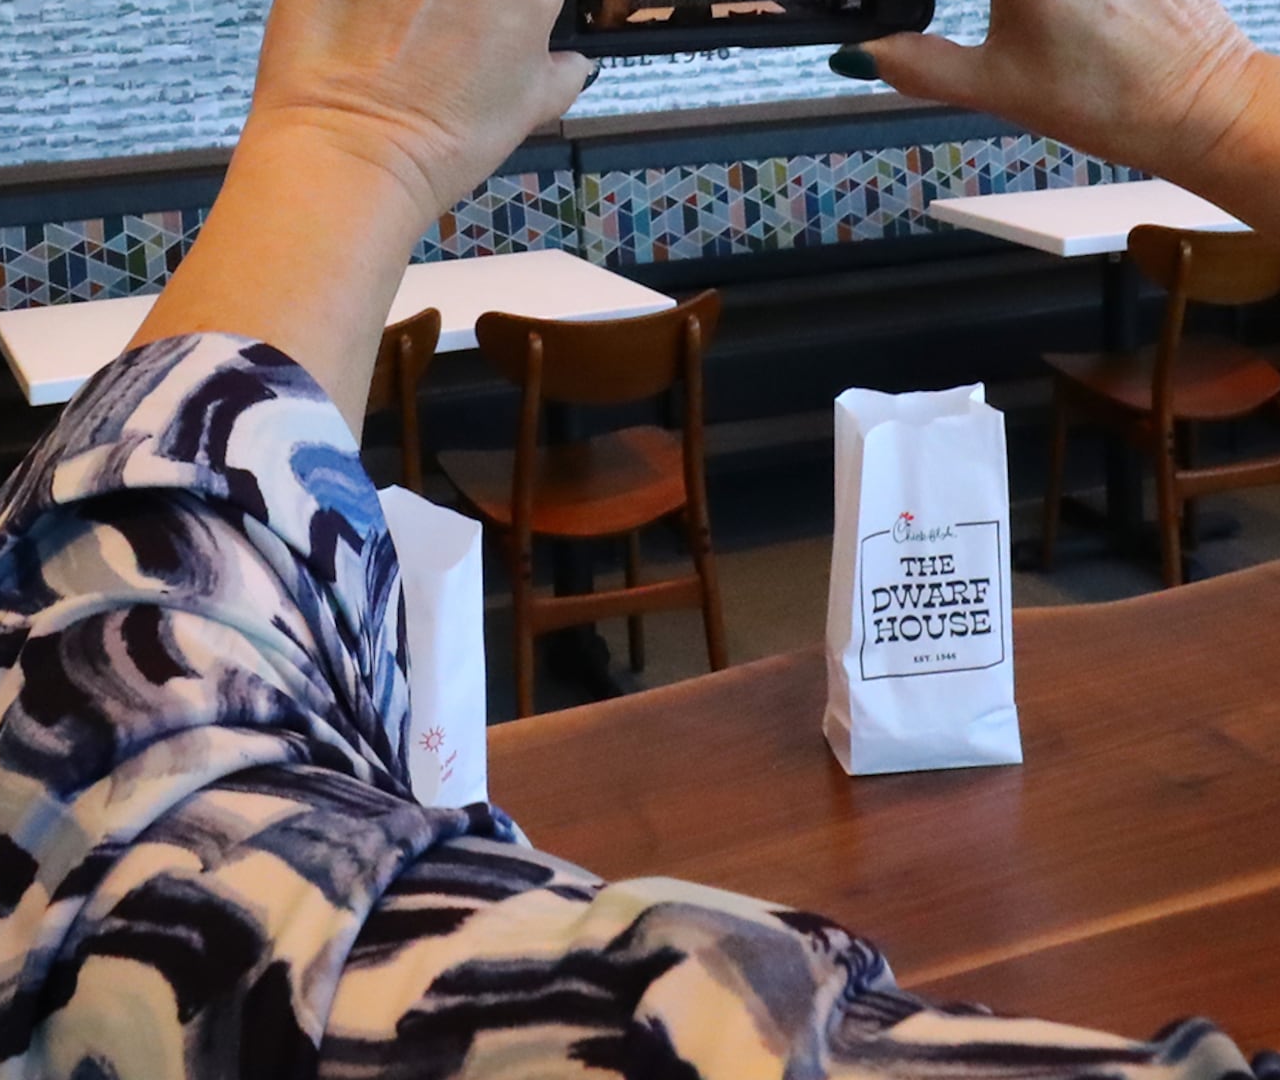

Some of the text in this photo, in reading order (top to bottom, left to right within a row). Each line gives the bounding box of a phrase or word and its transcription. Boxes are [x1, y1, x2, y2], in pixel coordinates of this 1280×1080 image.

[900, 554, 956, 577] THE
[871, 577, 991, 614] DWARF
[873, 610, 993, 644] HOUSE
